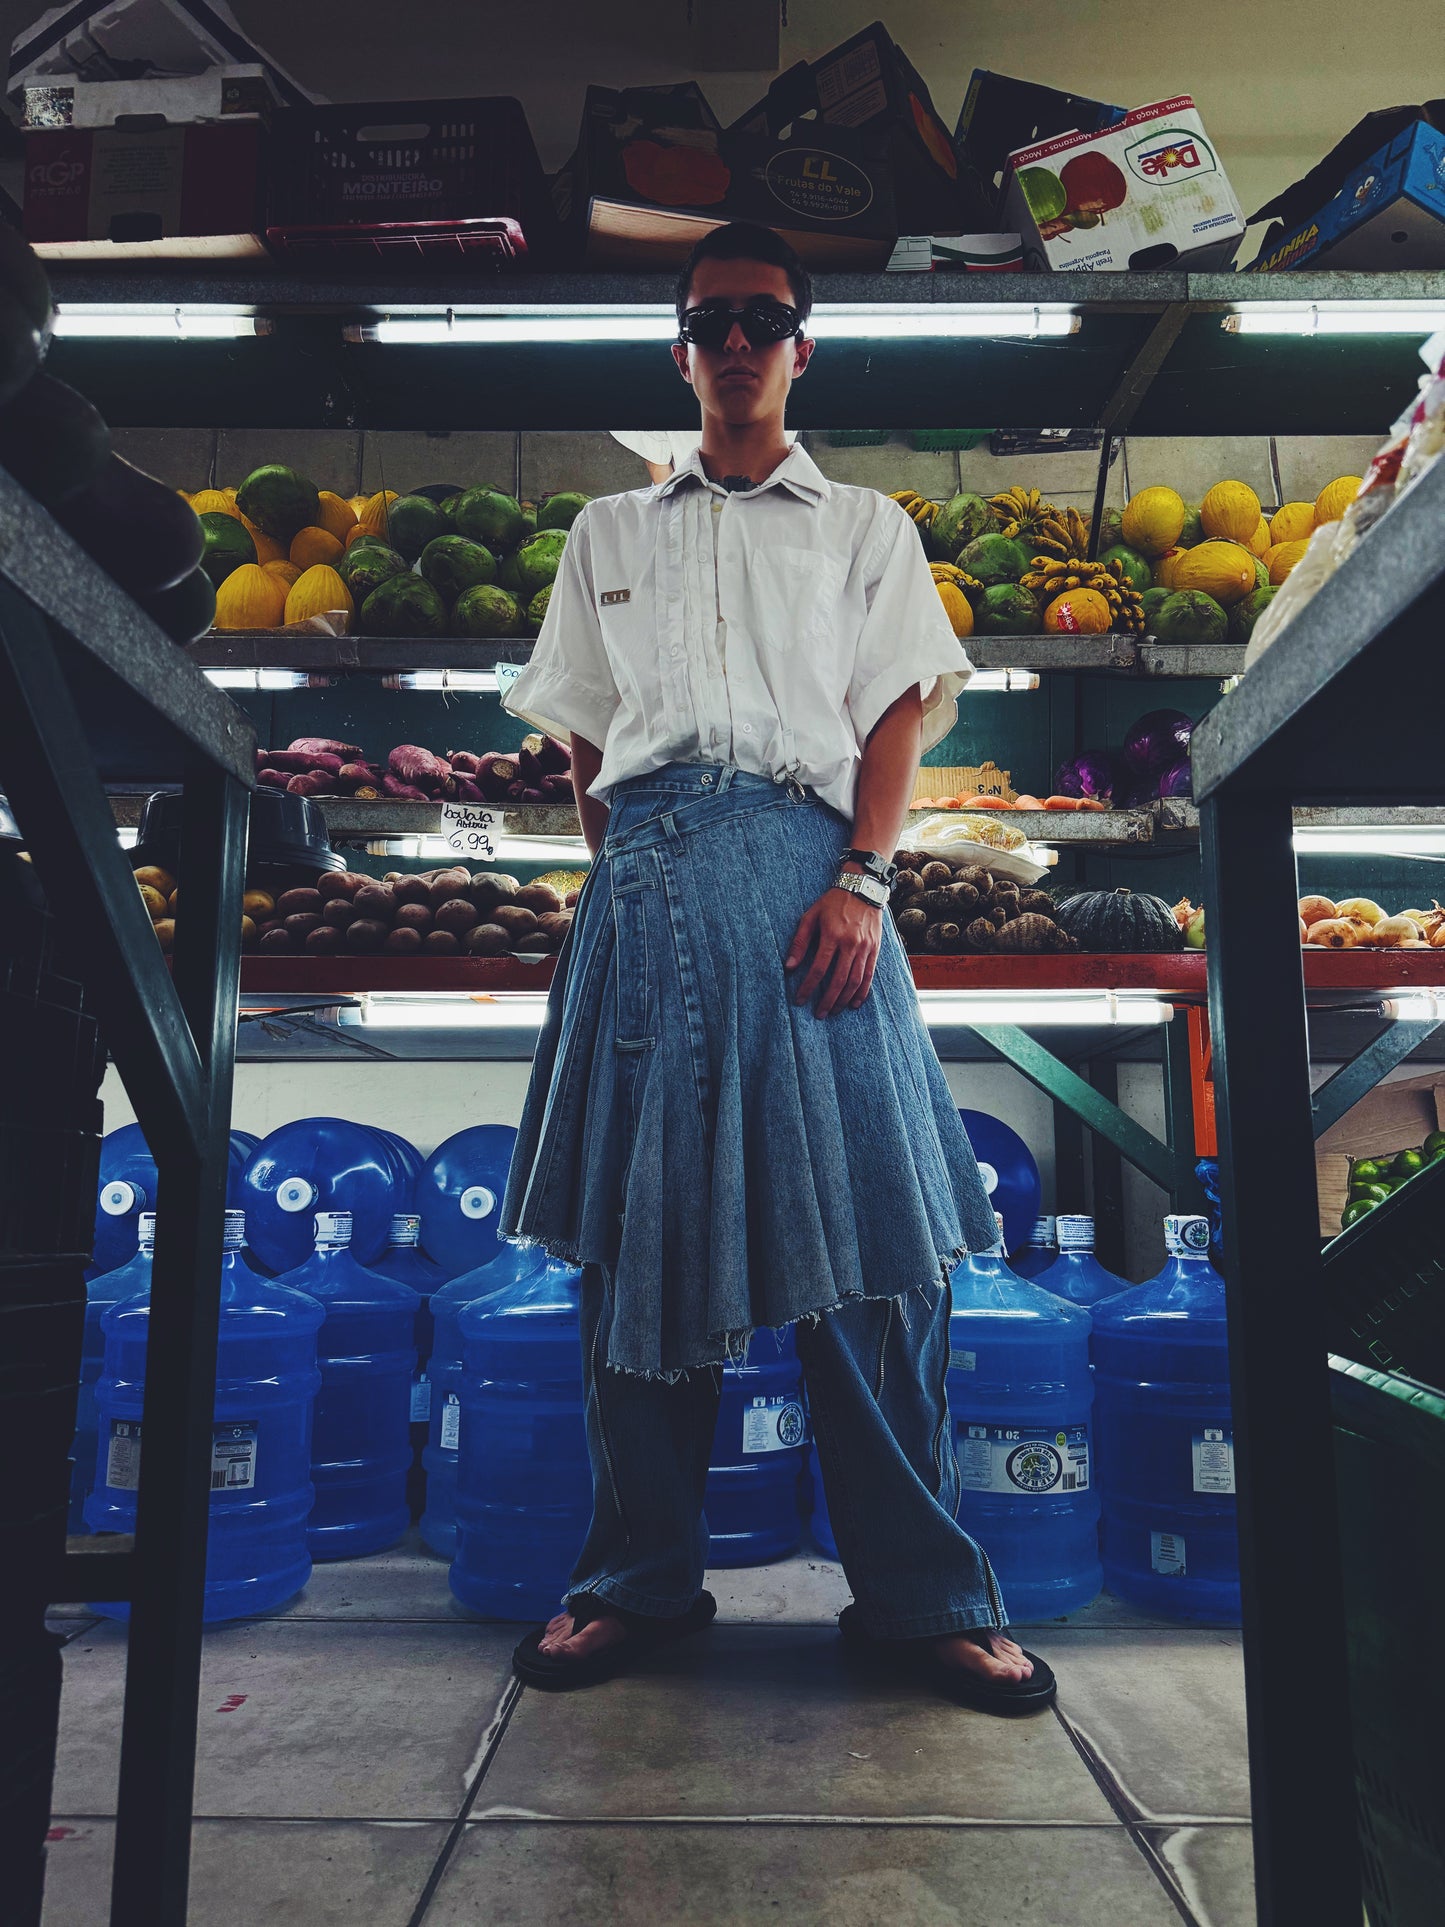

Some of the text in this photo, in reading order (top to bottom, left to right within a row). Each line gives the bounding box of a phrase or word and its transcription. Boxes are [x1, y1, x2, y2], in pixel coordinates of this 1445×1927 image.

[1140, 144, 1201, 178] Dole
[30, 160, 85, 186] AGP
[343, 179, 443, 195] MONTEIRO
[777, 175, 862, 197] Frutas do Vale
[1253, 223, 1319, 272] ALINHA
[1085, 249, 1111, 262] Patagonia
[1095, 256, 1113, 267] fresh
[977, 784, 985, 794] 3
[994, 1428, 1002, 1440] L
[1005, 1429, 1020, 1440] 20
